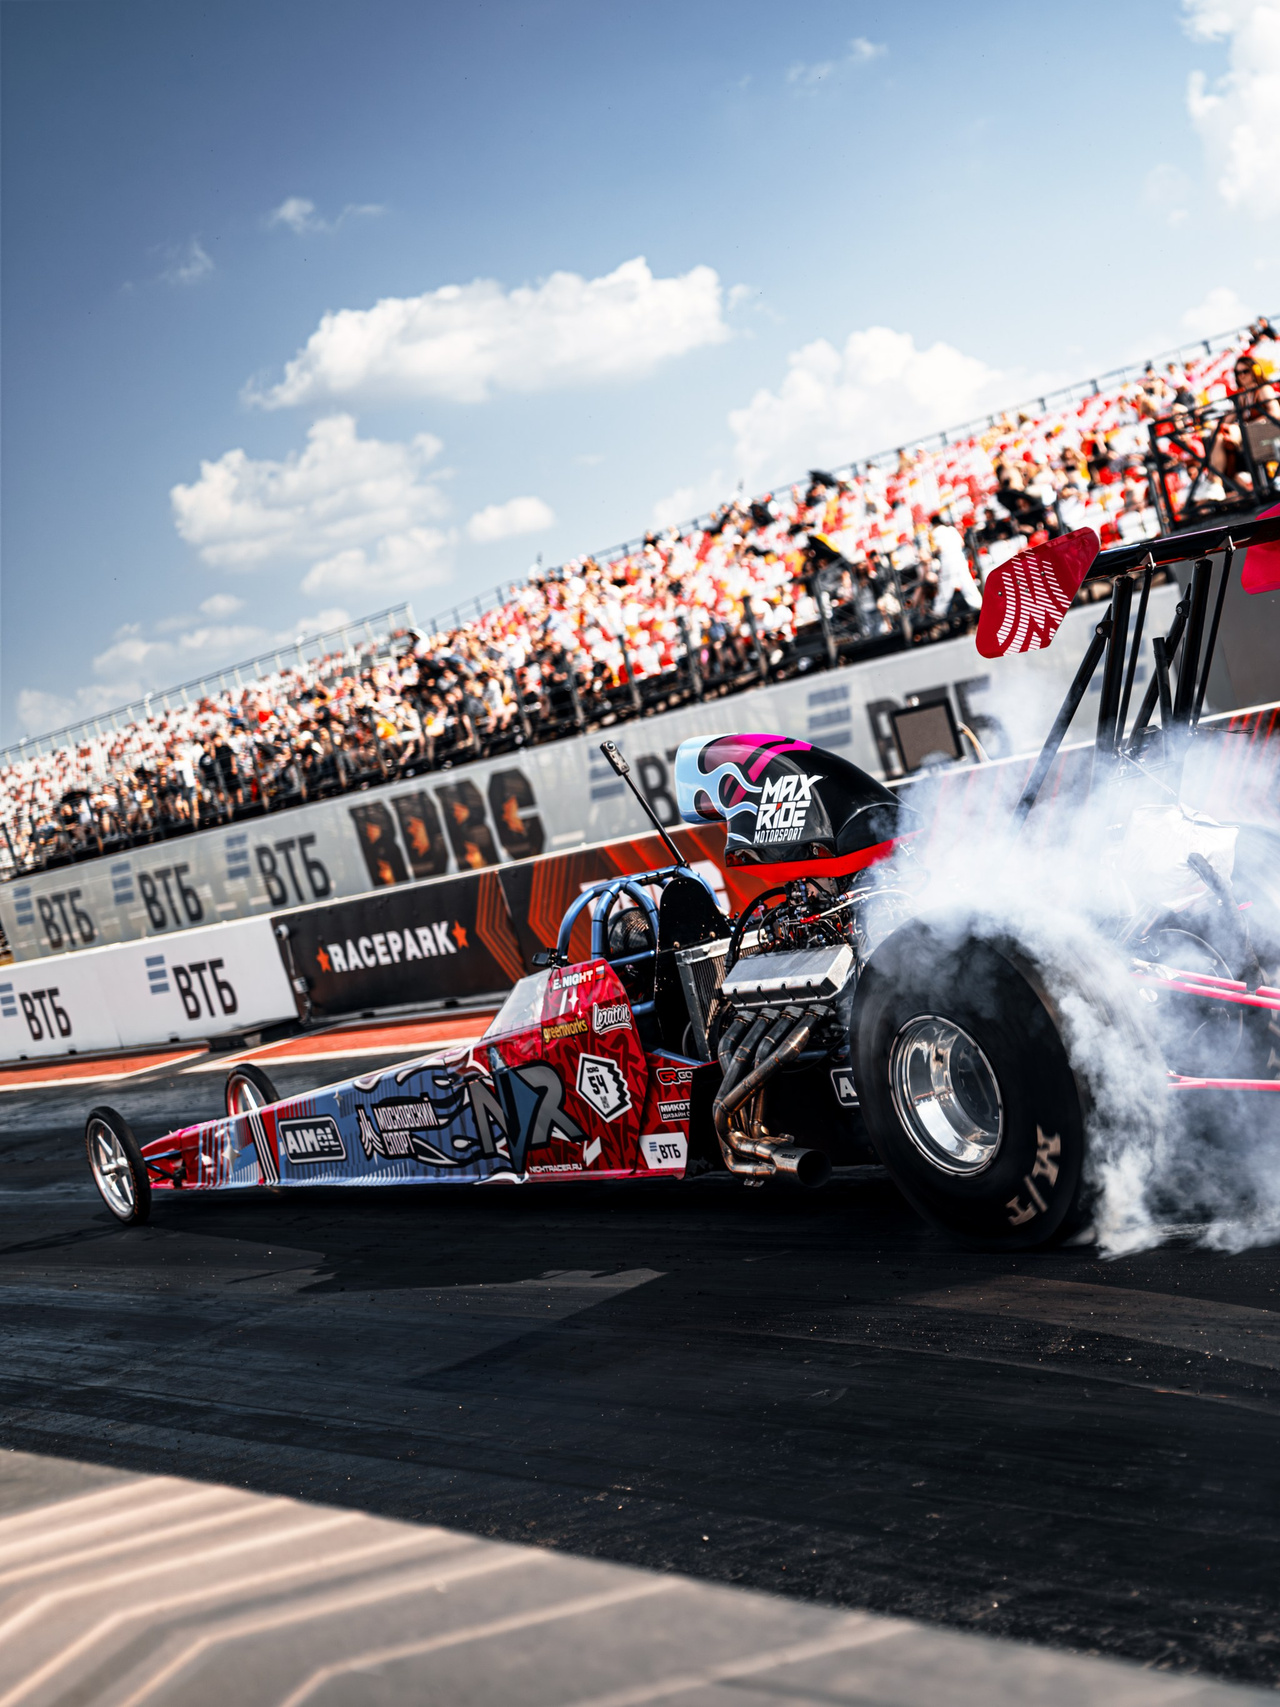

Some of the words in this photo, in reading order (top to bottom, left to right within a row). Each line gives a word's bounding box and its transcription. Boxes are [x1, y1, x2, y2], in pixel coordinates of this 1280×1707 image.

[760, 774, 824, 804] MAX
[348, 768, 546, 888] RDRC
[756, 800, 811, 830] RIDE
[753, 827, 804, 844] MOTORSPORT
[254, 831, 333, 908] ВТБ
[137, 861, 205, 930] ВТБ
[36, 889, 97, 948] ВТБ
[327, 920, 457, 973] RACEPARK
[172, 958, 238, 1020] ВТБ
[552, 978, 562, 991] E.
[562, 969, 594, 988] NIGHT
[18, 987, 72, 1041] ВТБ
[543, 1017, 588, 1043] greenworks
[588, 1074, 609, 1095] 54
[374, 1097, 439, 1131] МОСКОВСКИЙ
[382, 1131, 416, 1156] СПОРТ
[658, 1143, 682, 1159] ВТБ
